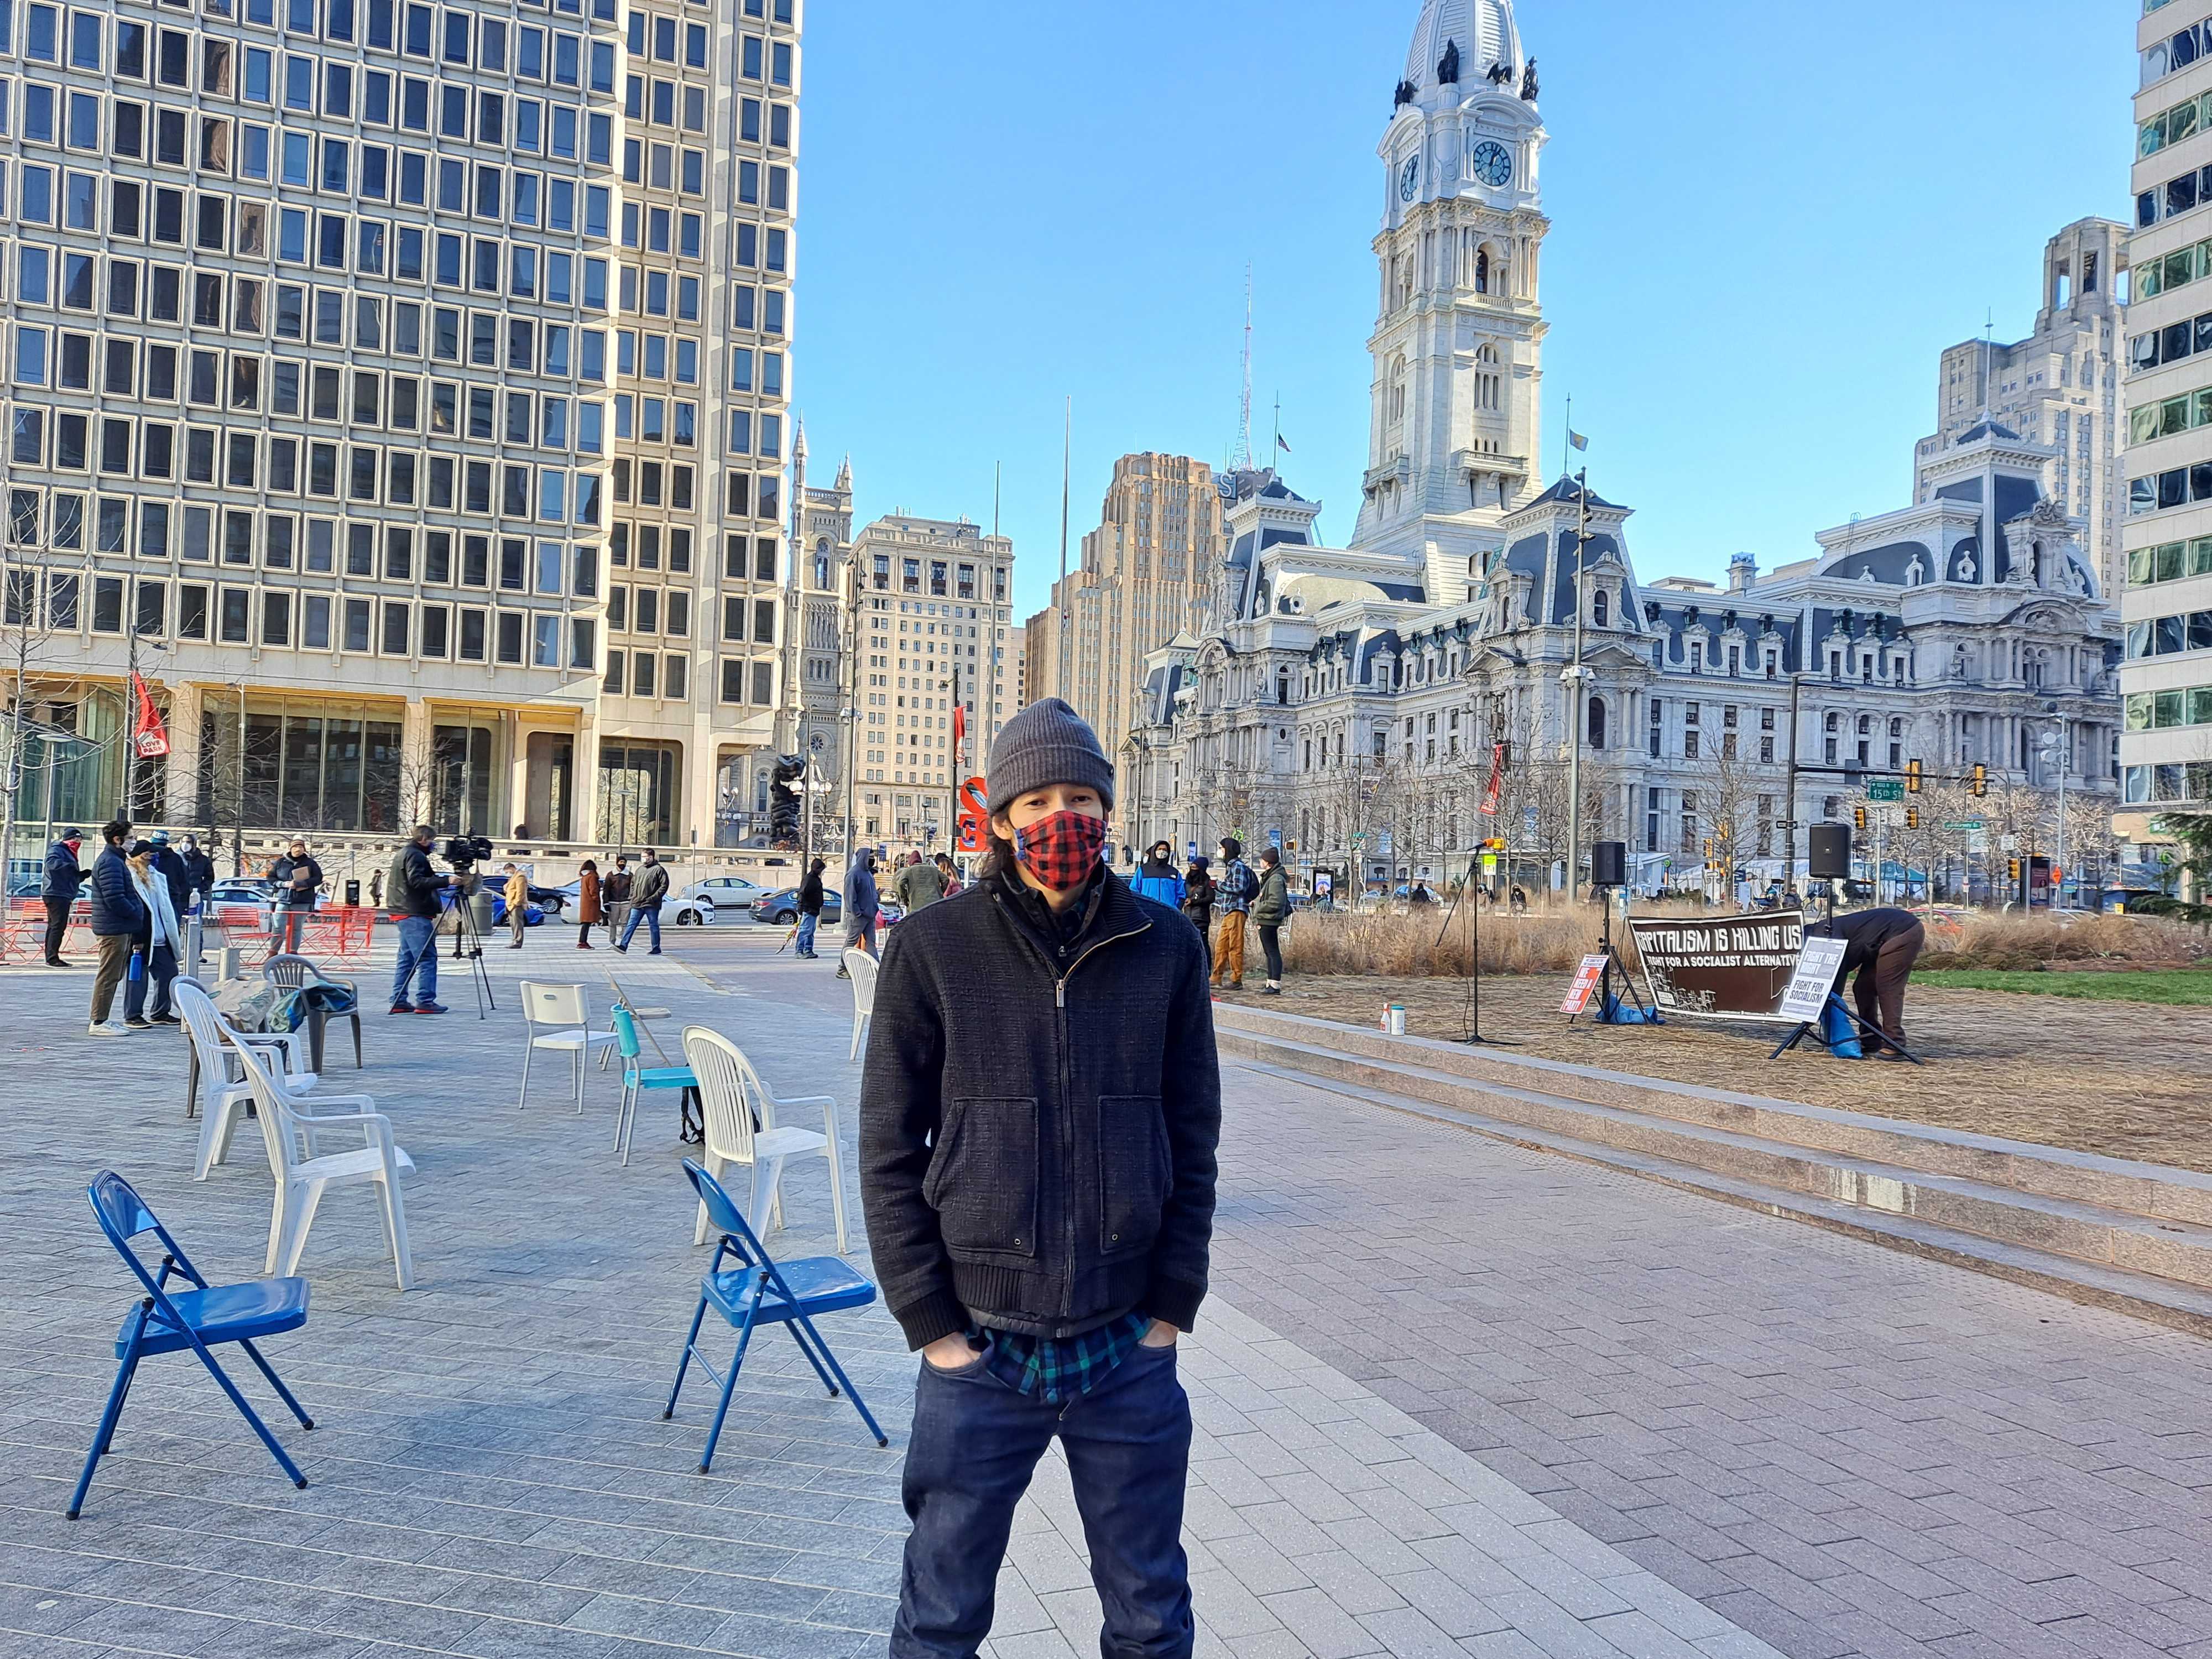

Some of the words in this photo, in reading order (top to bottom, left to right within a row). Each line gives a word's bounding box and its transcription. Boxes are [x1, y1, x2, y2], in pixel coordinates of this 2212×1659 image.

[1873, 789, 1890, 799] 15th
[1635, 929, 1710, 953] CAPITALISM
[1714, 928, 1729, 952] IS
[1731, 925, 1780, 951] KILLING
[1783, 925, 1802, 950] US
[1646, 956, 1665, 967] FIGHT
[1665, 956, 1682, 967] FOR
[1683, 957, 1690, 967] A
[1691, 956, 1741, 967] SOCIALIST
[1744, 954, 1799, 967] ALTERNATIVE
[1804, 951, 1825, 964] FIGHT
[1824, 953, 1839, 965] THE
[1793, 979, 1812, 991] FIGHT
[1812, 982, 1825, 992] FOR
[1790, 989, 1824, 1003] SOCIALISM
